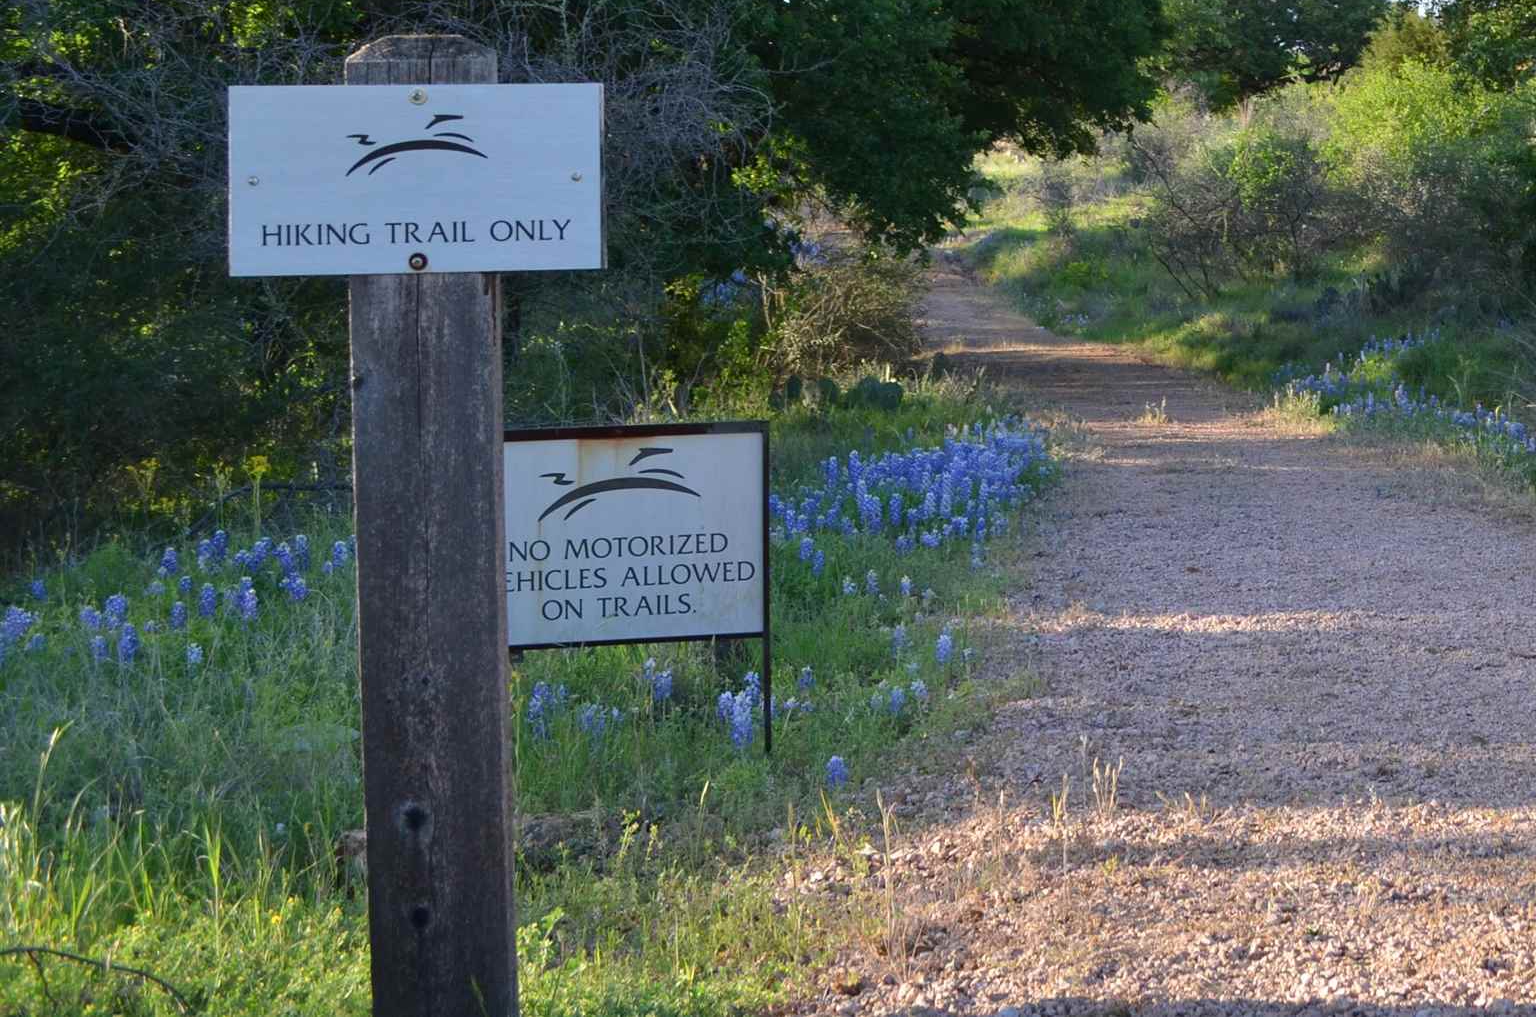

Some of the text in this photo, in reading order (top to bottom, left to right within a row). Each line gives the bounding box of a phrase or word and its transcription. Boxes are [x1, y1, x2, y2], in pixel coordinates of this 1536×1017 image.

[261, 219, 571, 247] HIKING TRAIL ONLY
[509, 533, 729, 562] NO MOTORIZED
[505, 560, 756, 593] EHICLES ALLOWED
[541, 593, 697, 621] ON TRAILS.
